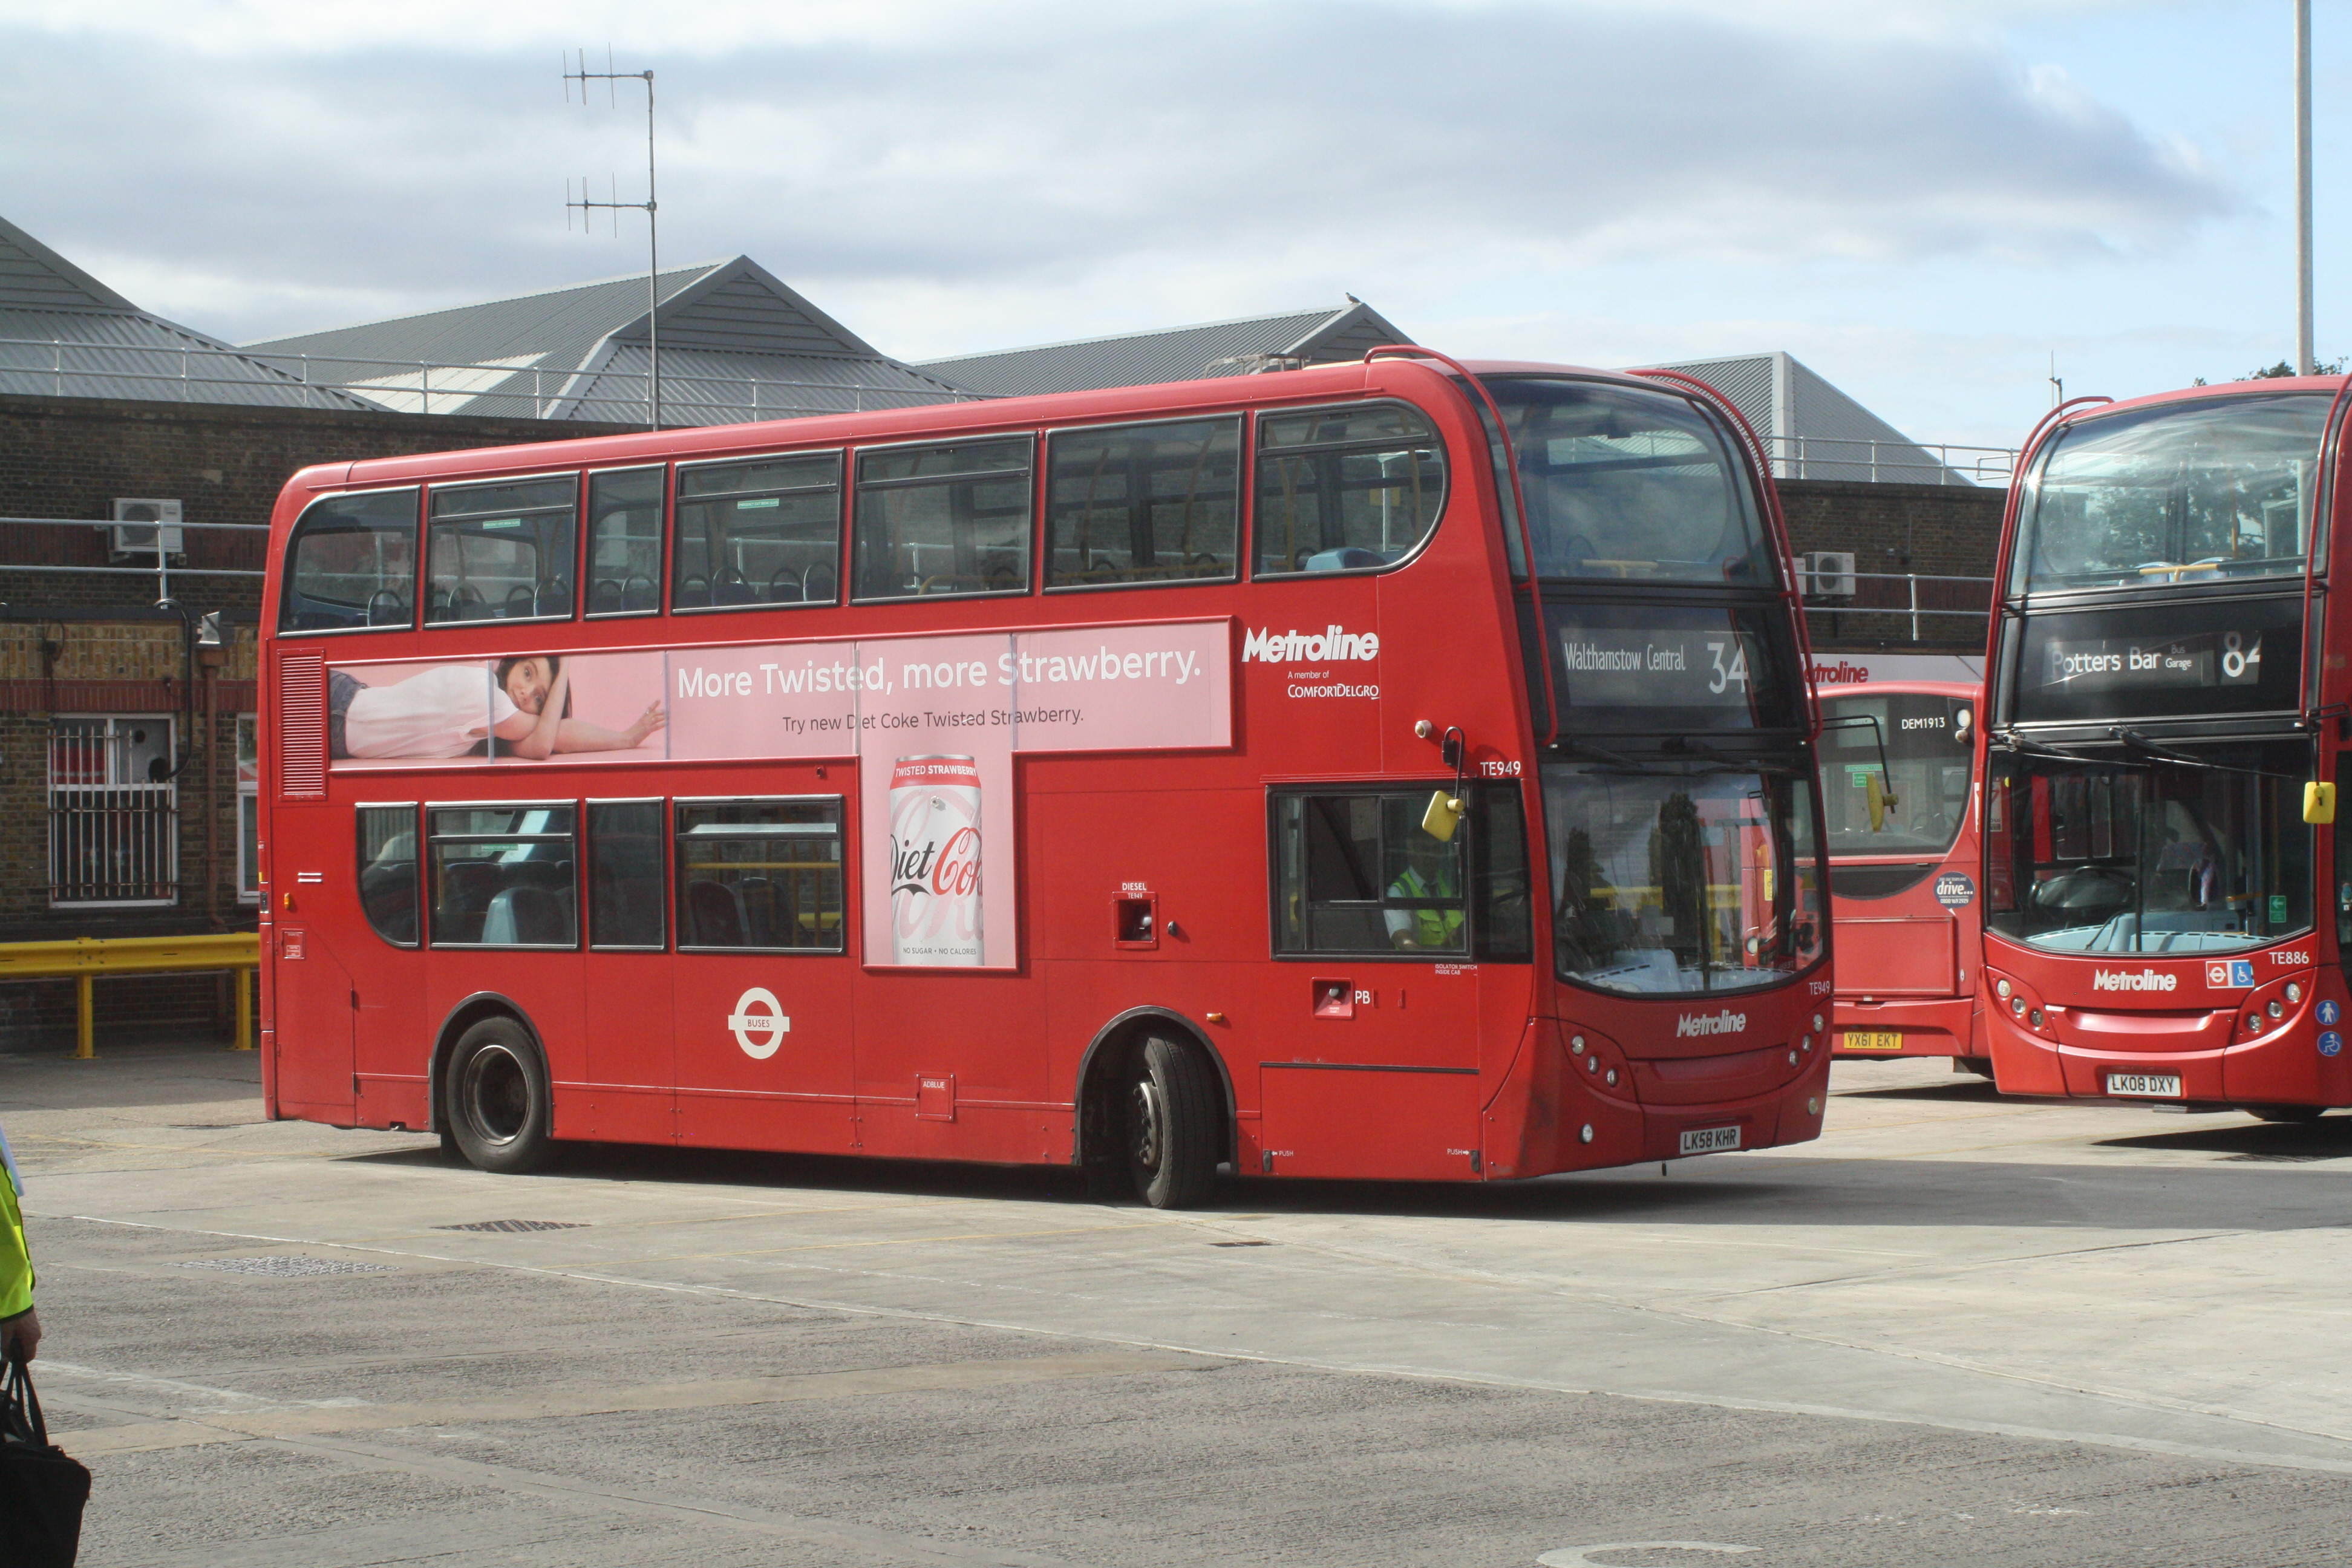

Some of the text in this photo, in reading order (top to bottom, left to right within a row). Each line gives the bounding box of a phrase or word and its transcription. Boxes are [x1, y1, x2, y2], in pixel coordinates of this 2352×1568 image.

[1241, 625, 1379, 663] Metroline
[2171, 644, 2186, 654] Bus
[2223, 631, 2261, 678] 84
[1564, 643, 1686, 671] Walthamstow Central
[2052, 647, 2191, 673] Potters Bar Garage
[679, 646, 1201, 698] More Twisted, more Strawberry.
[1707, 642, 1748, 694] 34
[783, 707, 1083, 734] Try new Det Coke Twisted Strawberry.
[1901, 716, 1945, 730] DEM1913
[895, 765, 977, 777] TWISTED STRAWBERRY
[1480, 760, 1521, 776] TE949
[2269, 952, 2310, 964] TE886
[1809, 981, 1830, 995] TE949
[2093, 969, 2177, 991] Metroline
[1354, 990, 1370, 1004] PB
[1676, 1010, 1746, 1037] Metroline
[1847, 1034, 1898, 1047] YX61 EKT
[2112, 1076, 2174, 1093] LK08 DXY
[1684, 1129, 1736, 1150] LK58 KHR
